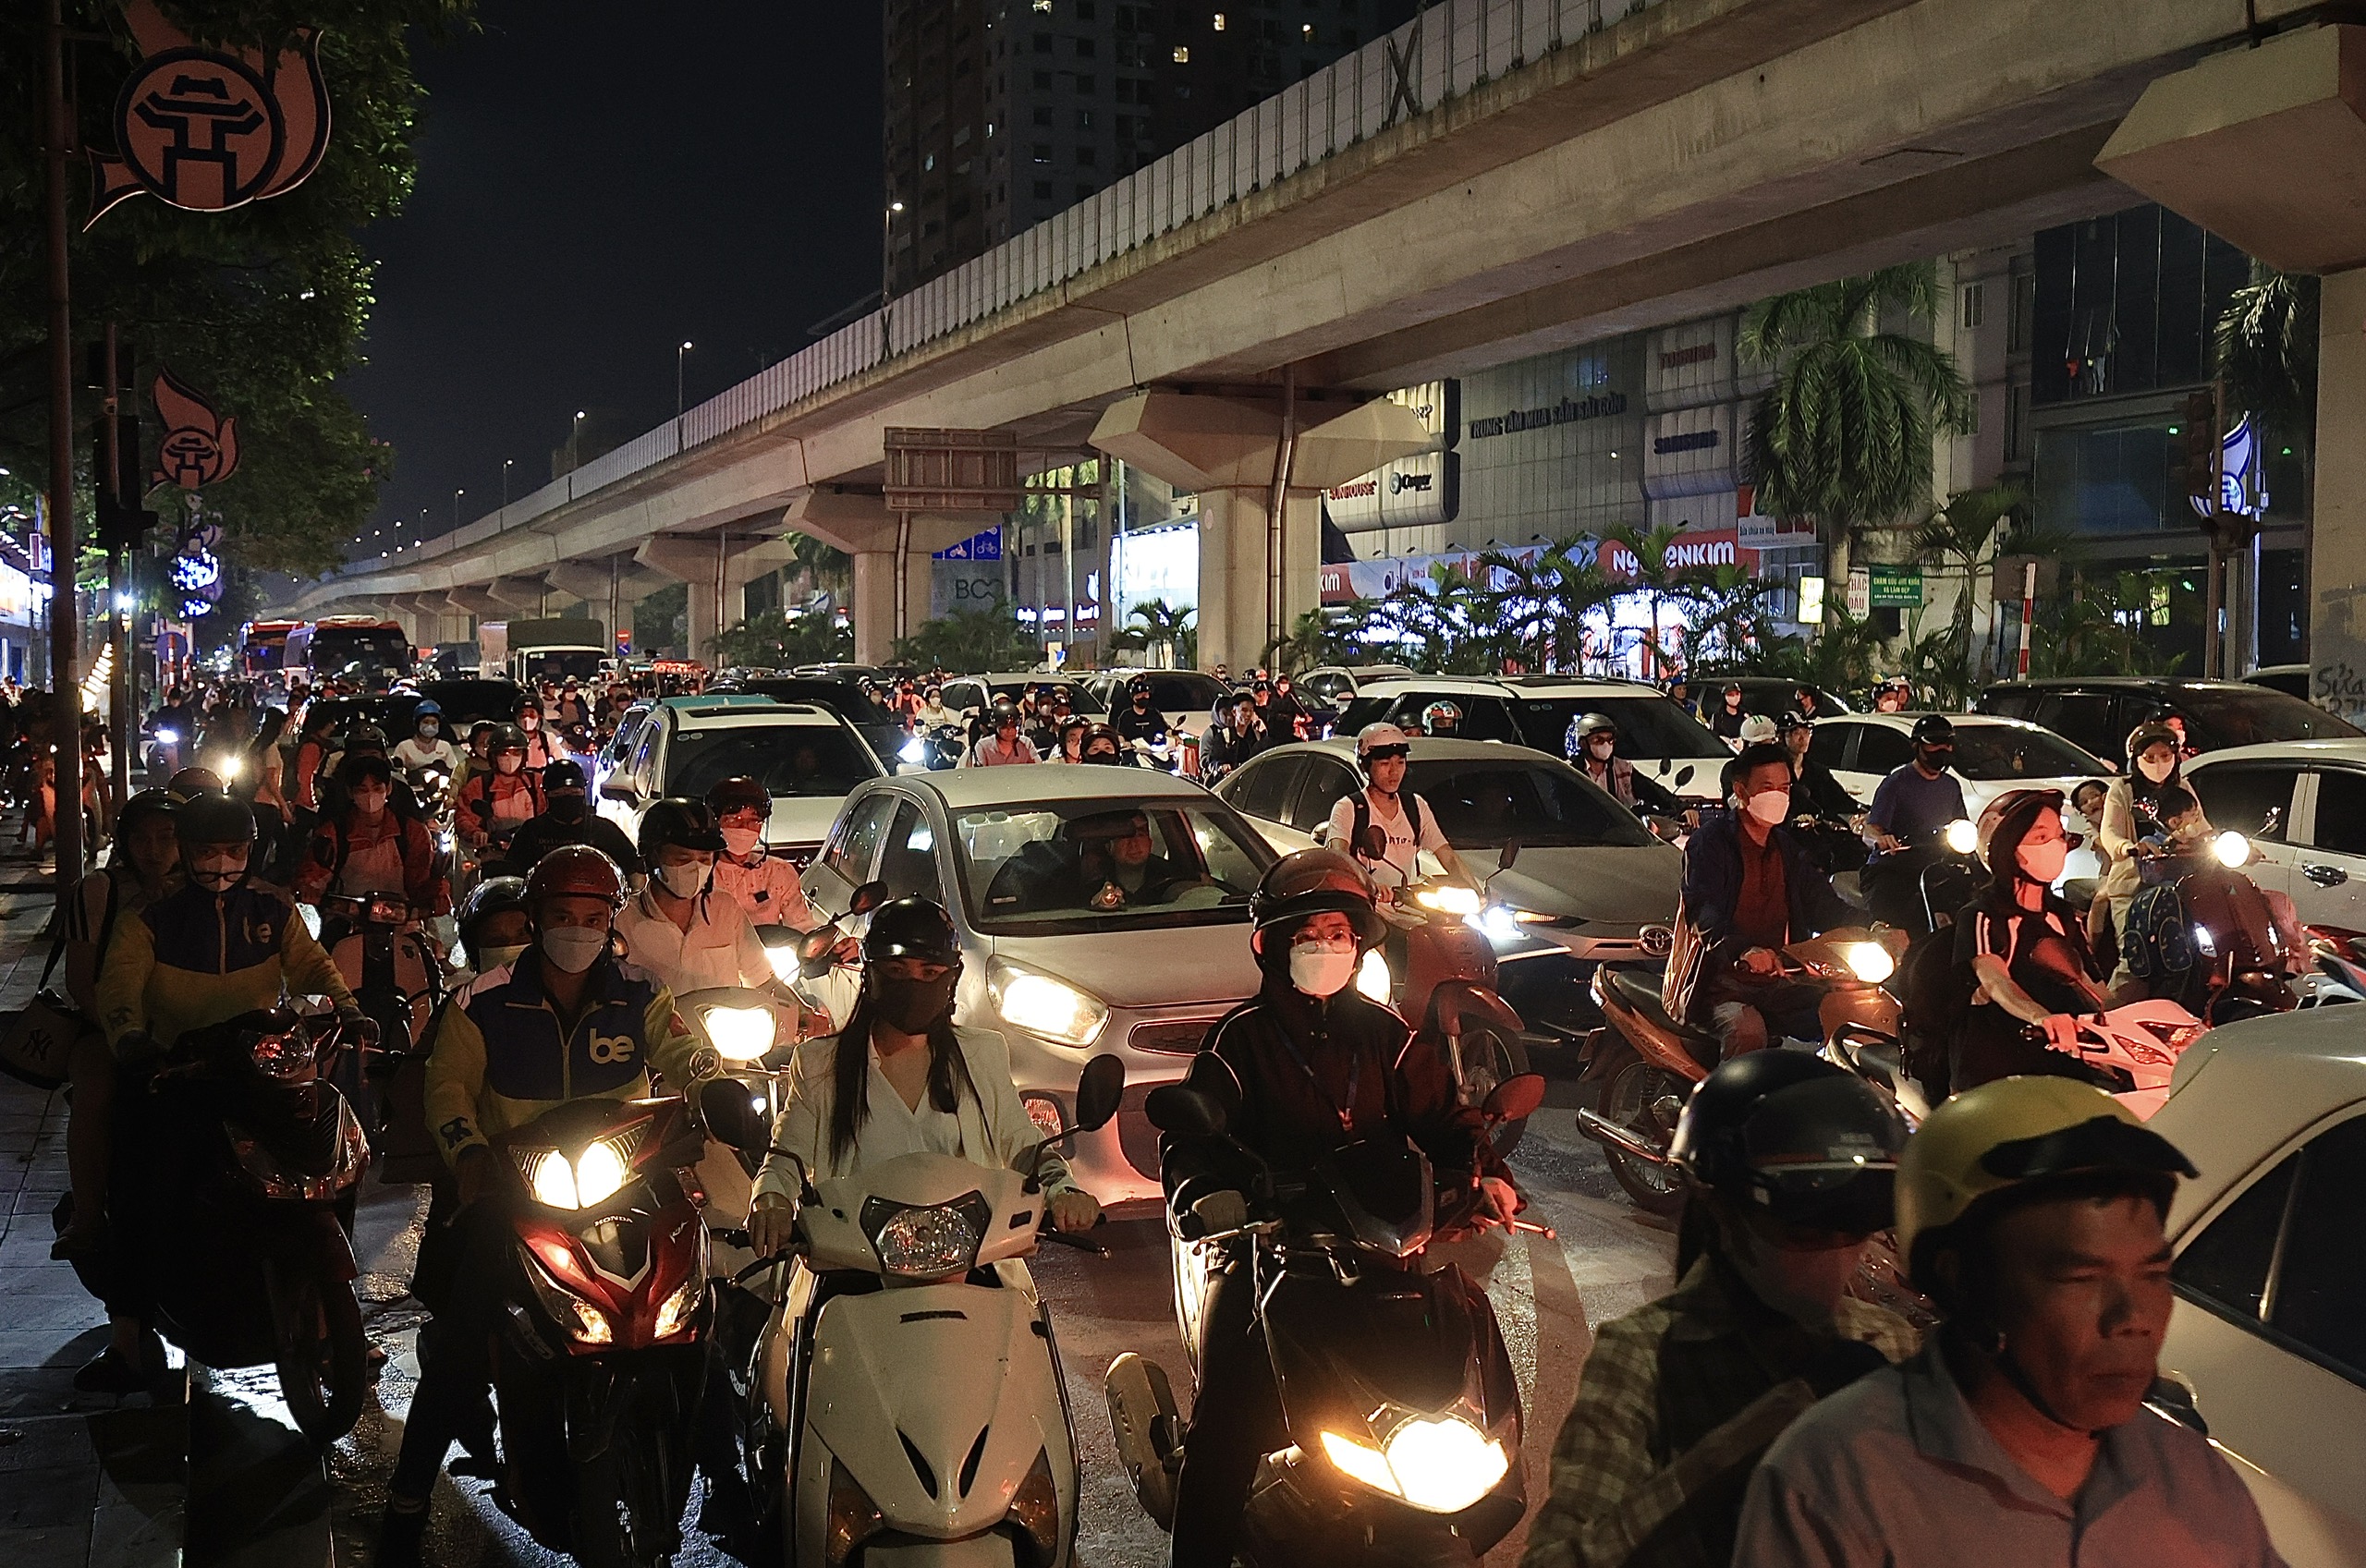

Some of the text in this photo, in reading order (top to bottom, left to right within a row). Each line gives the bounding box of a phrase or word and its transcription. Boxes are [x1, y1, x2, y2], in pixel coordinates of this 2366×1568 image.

[1329, 480, 1377, 501] SUNHOUSE
[589, 1027, 636, 1065] be
[594, 1215, 633, 1227] HONDA
